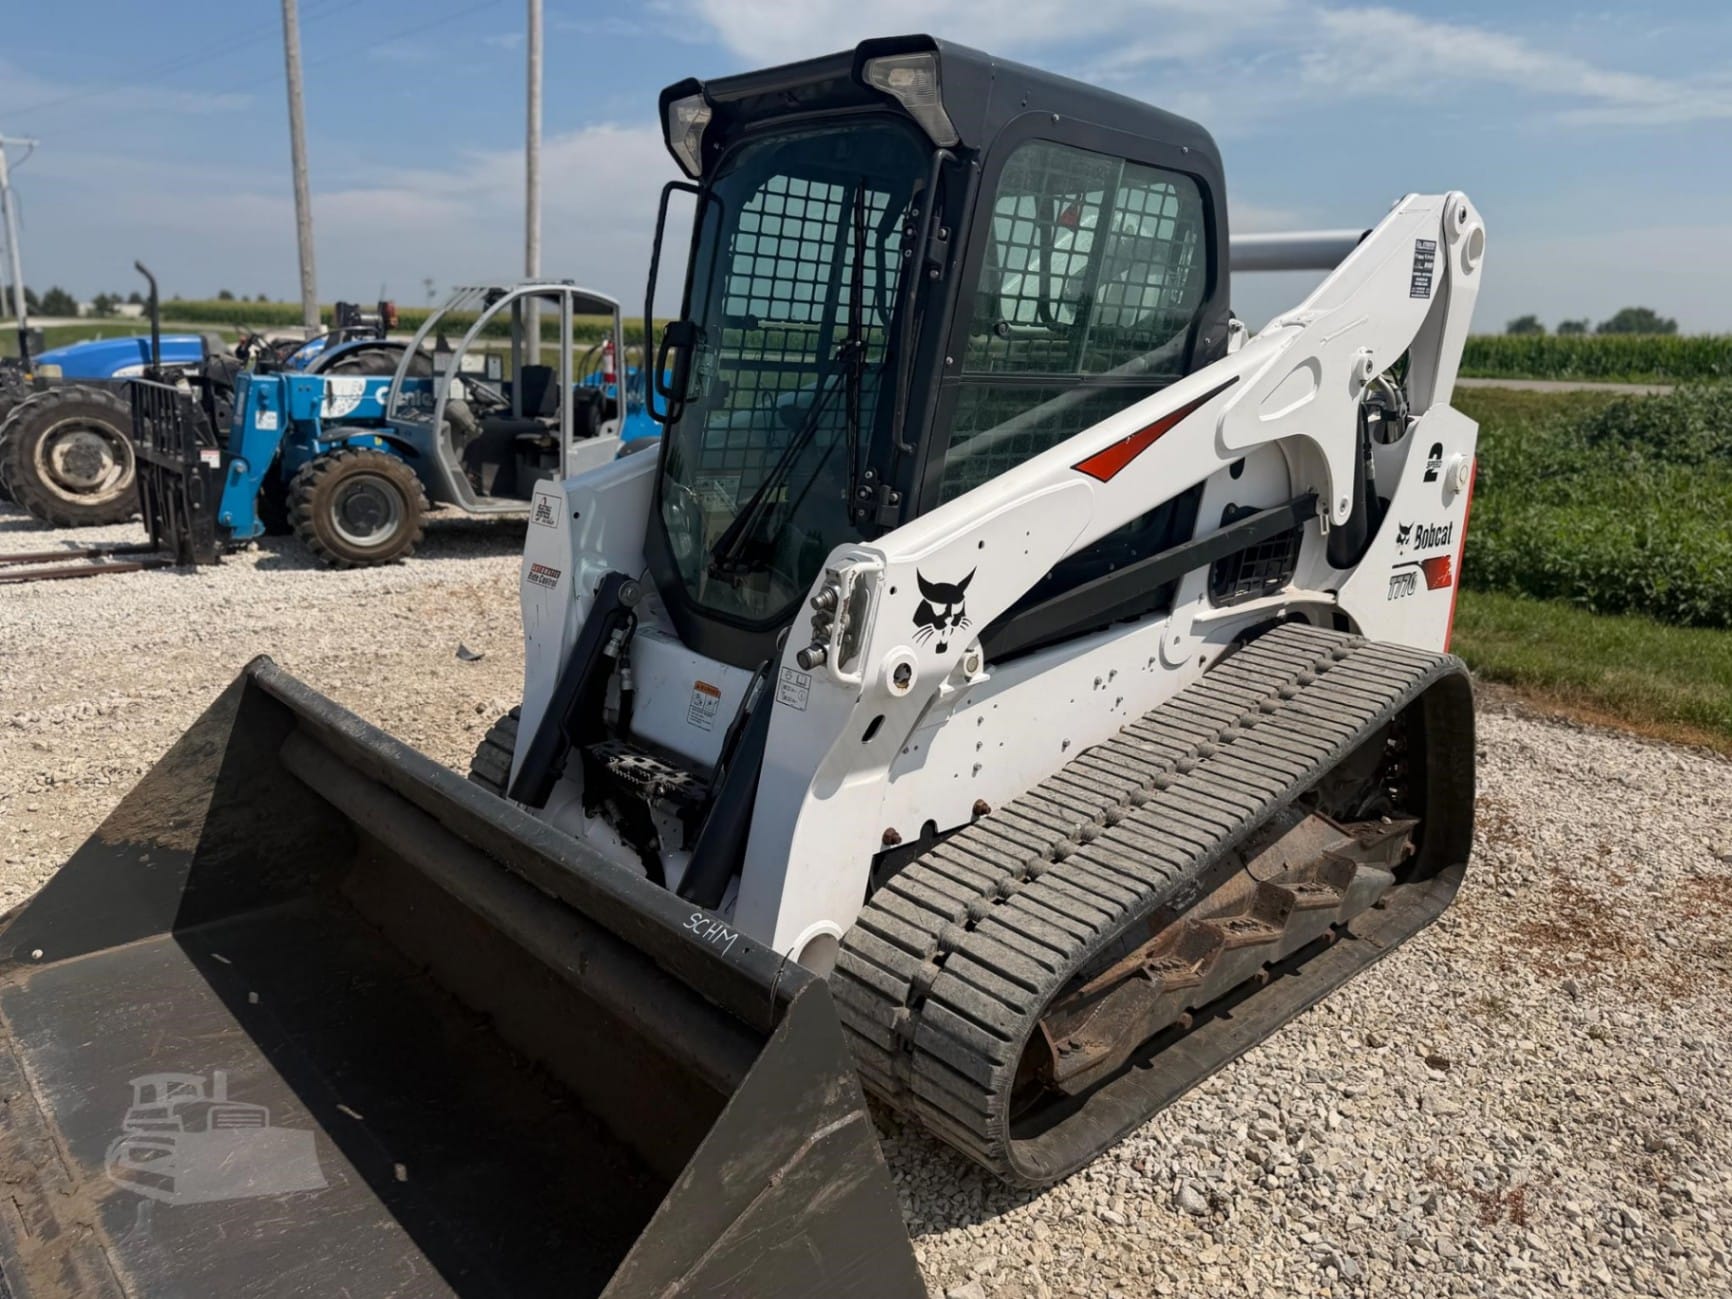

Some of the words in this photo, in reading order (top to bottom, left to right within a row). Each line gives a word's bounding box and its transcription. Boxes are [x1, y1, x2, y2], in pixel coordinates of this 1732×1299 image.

[1414, 521, 1453, 550] Bobcat
[1388, 571, 1417, 601] T770
[682, 912, 739, 959] SCHM
